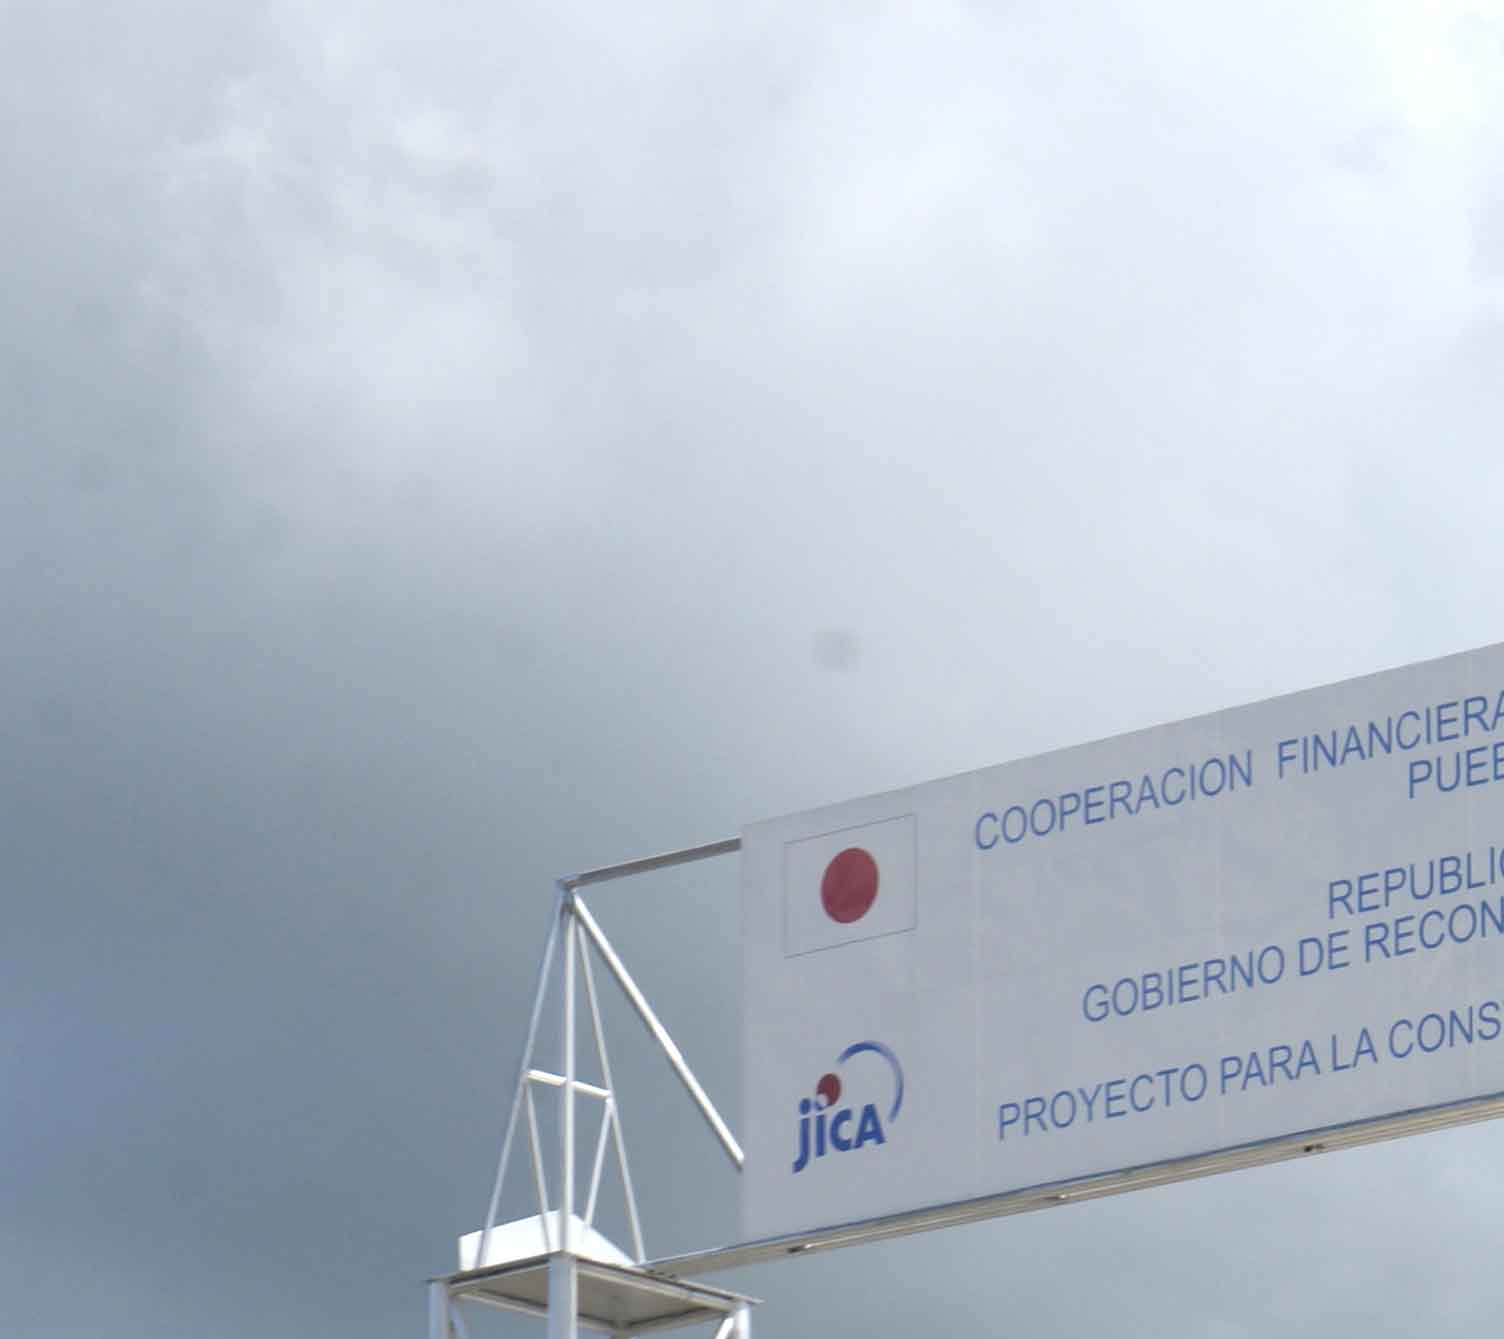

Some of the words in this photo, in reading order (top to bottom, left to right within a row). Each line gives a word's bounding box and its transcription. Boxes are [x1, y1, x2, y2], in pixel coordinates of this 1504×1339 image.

[975, 749, 1253, 851] COOPERACION
[1082, 945, 1285, 1023] GOBIERNO
[1297, 929, 1351, 977] DE
[999, 1063, 1208, 1140] PROYECTO
[1220, 1039, 1321, 1095] PARA
[1331, 1027, 1379, 1073] LA
